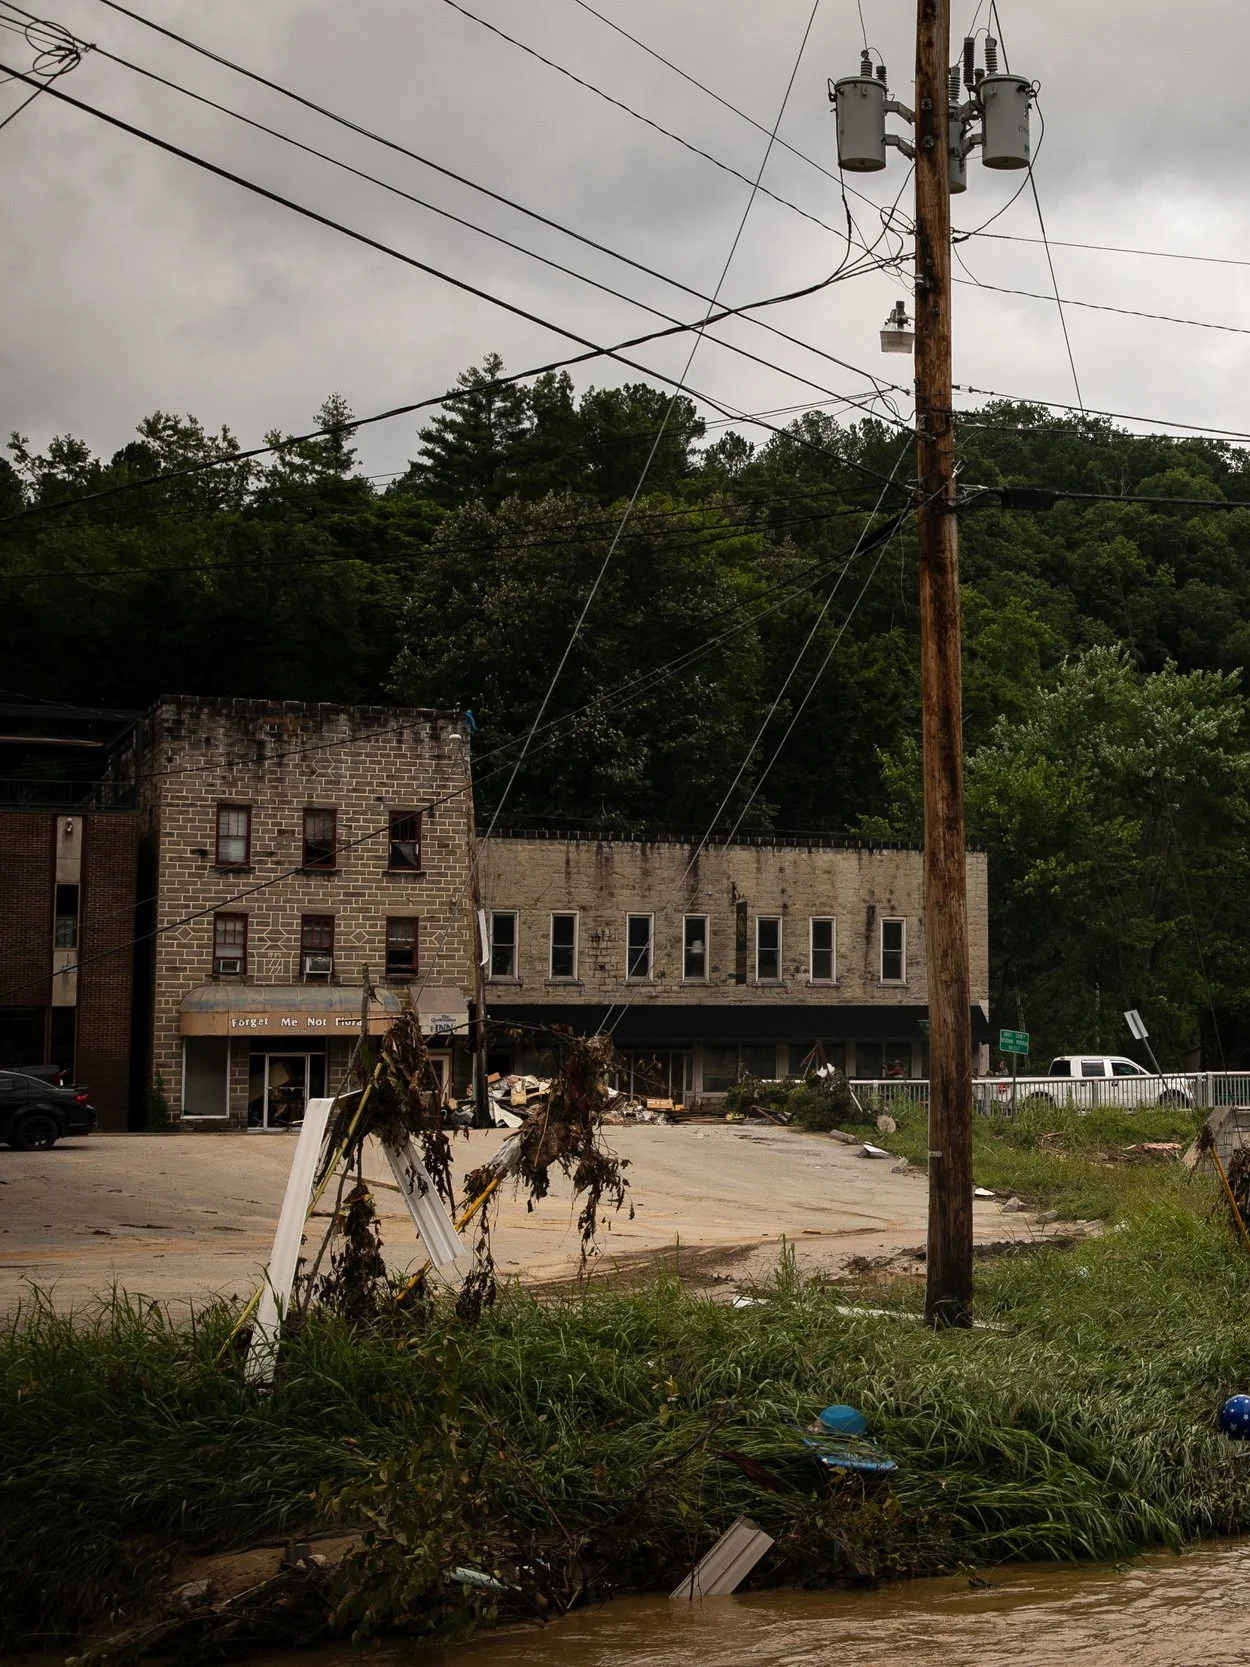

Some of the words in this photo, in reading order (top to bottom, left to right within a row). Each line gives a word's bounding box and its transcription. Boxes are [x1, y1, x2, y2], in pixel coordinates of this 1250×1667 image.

[231, 1017, 269, 1028] Forget
[280, 1018, 298, 1027] Me
[307, 1017, 327, 1027] Not
